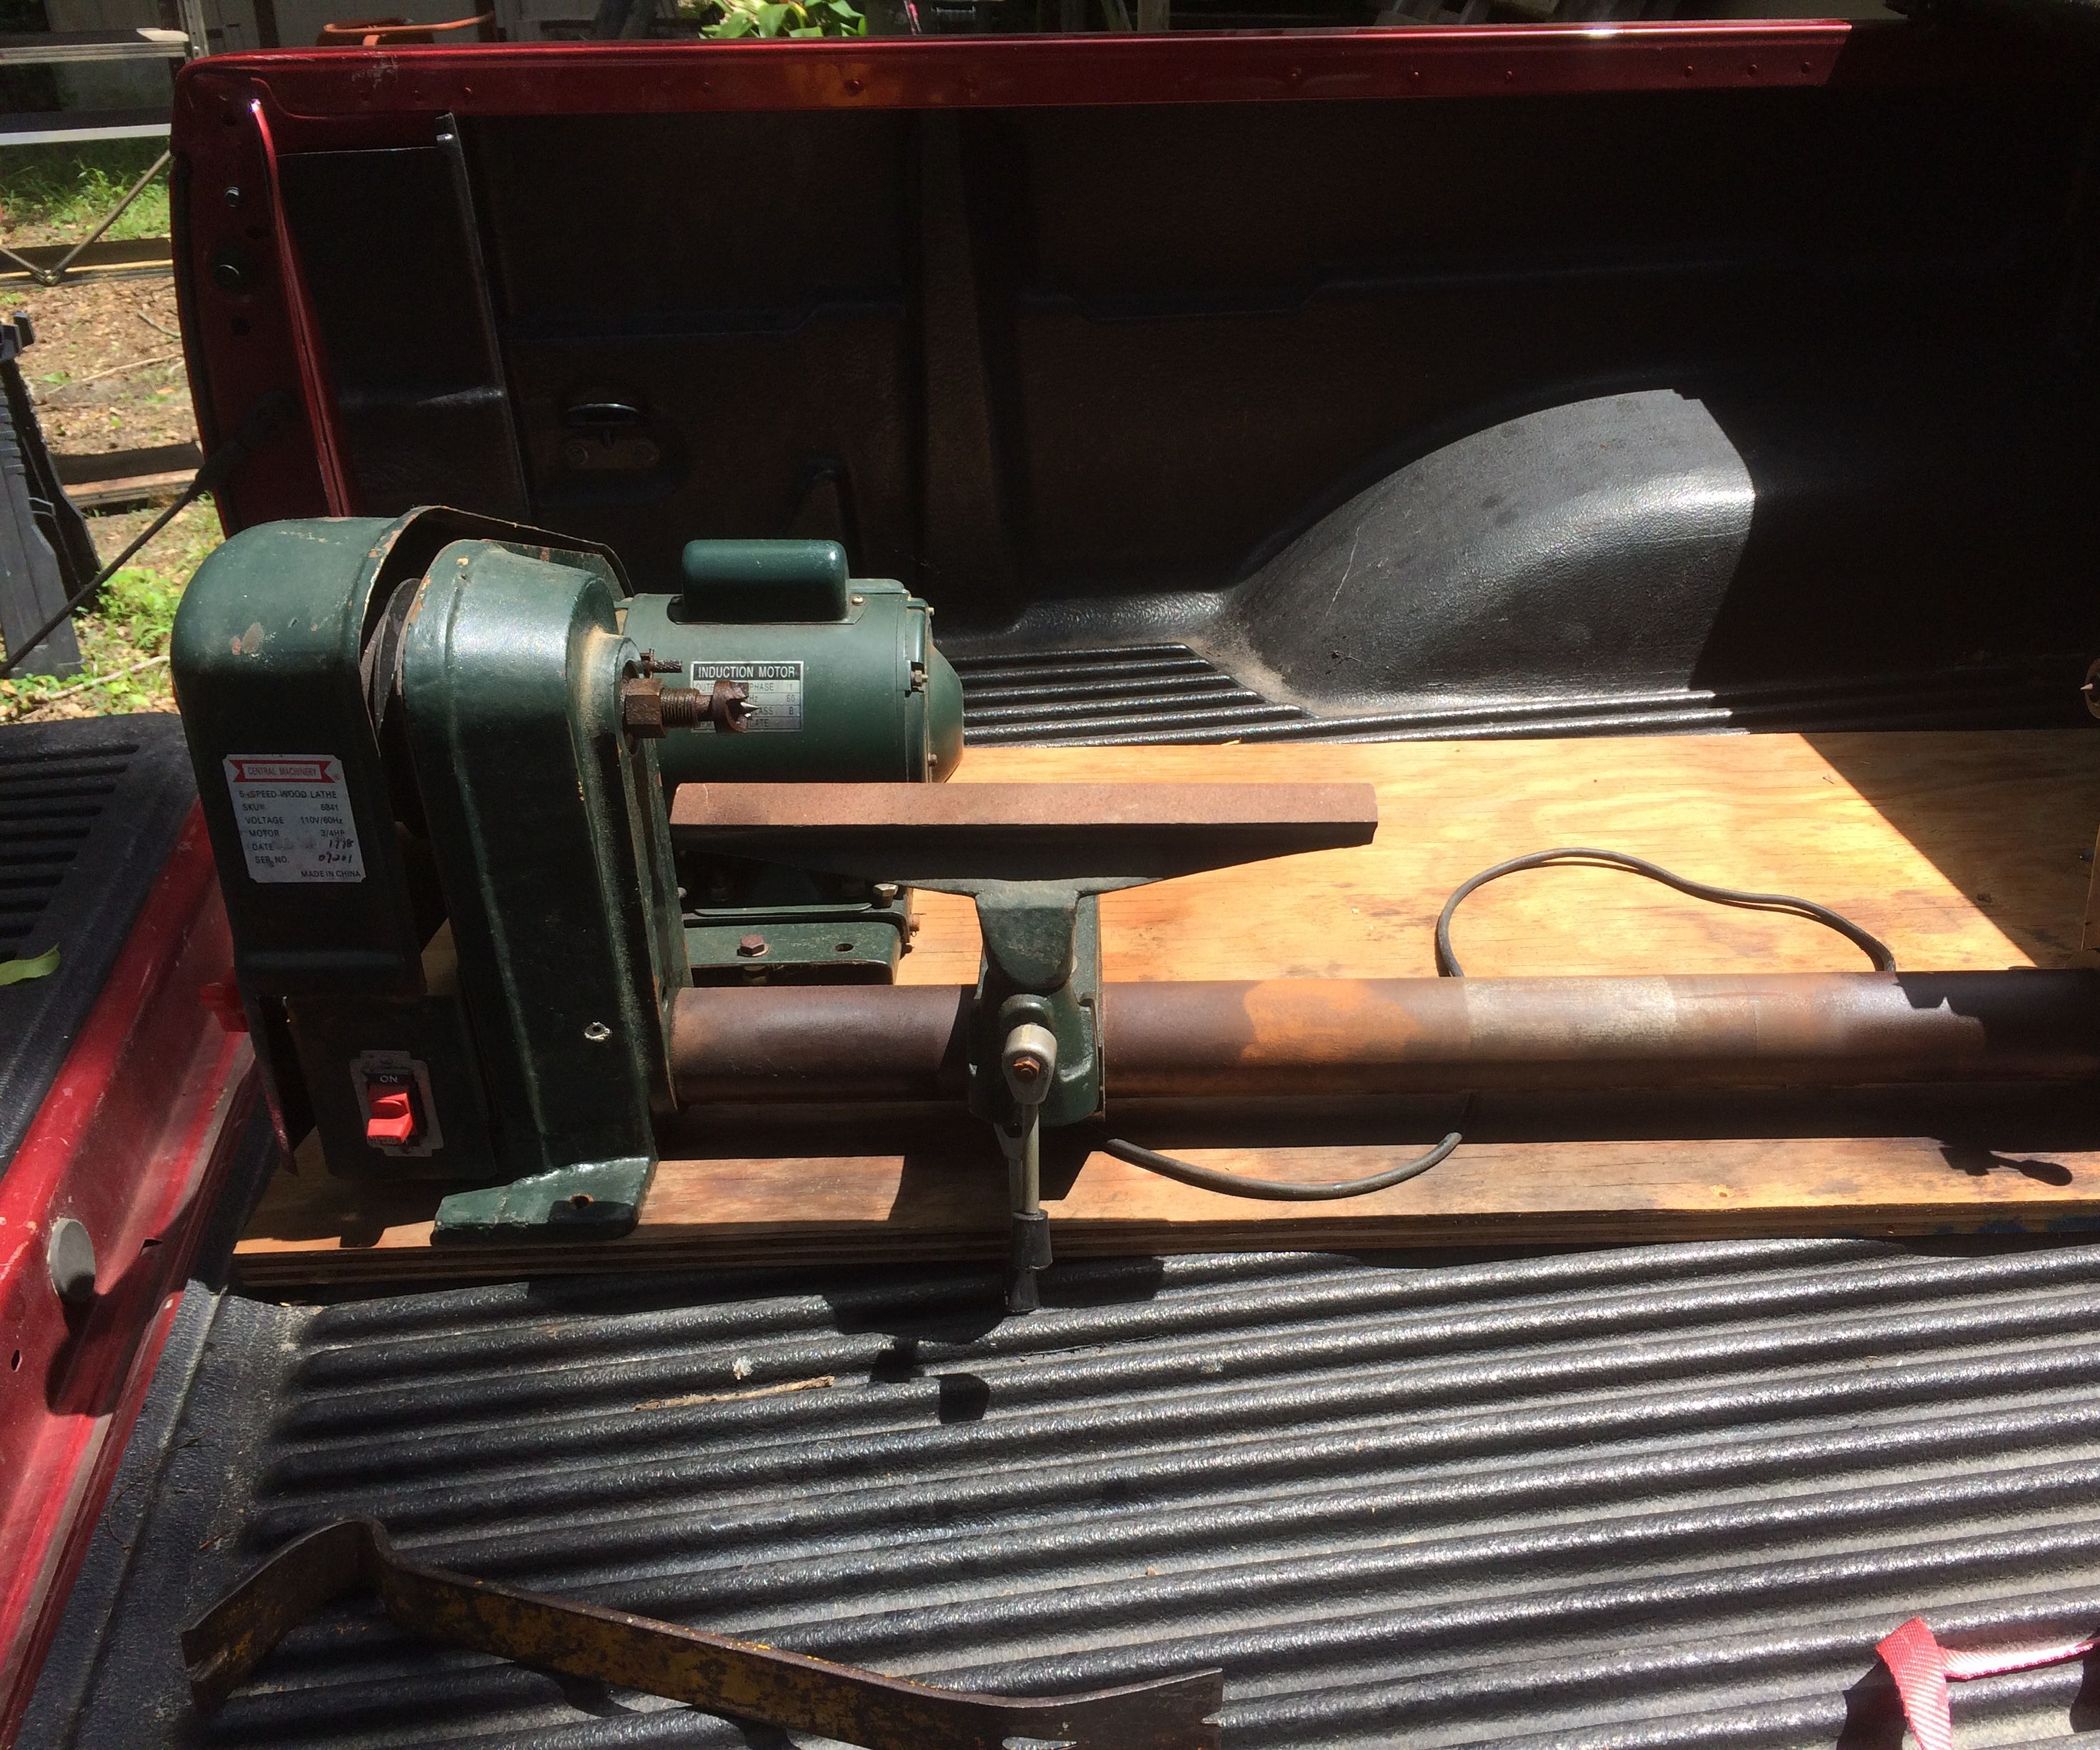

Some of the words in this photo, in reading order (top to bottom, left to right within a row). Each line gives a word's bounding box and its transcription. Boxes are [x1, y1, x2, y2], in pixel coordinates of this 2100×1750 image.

[698, 666, 754, 678] INDUCTION
[758, 666, 795, 678] MOTOR
[749, 682, 774, 691] PHASE
[247, 767, 277, 776] CENTRAL
[279, 767, 317, 777] MACHINERY
[310, 791, 337, 799] LATHE
[246, 816, 285, 825] VOLTAGE
[300, 817, 344, 825] 110V/60Hz
[249, 829, 280, 838] MOTOR
[320, 829, 345, 838] 3/4HP
[252, 843, 274, 851] DATE
[301, 870, 325, 878] MADE
[326, 870, 335, 878] IN
[336, 870, 361, 878] CHINA
[379, 1075, 399, 1084] ON
